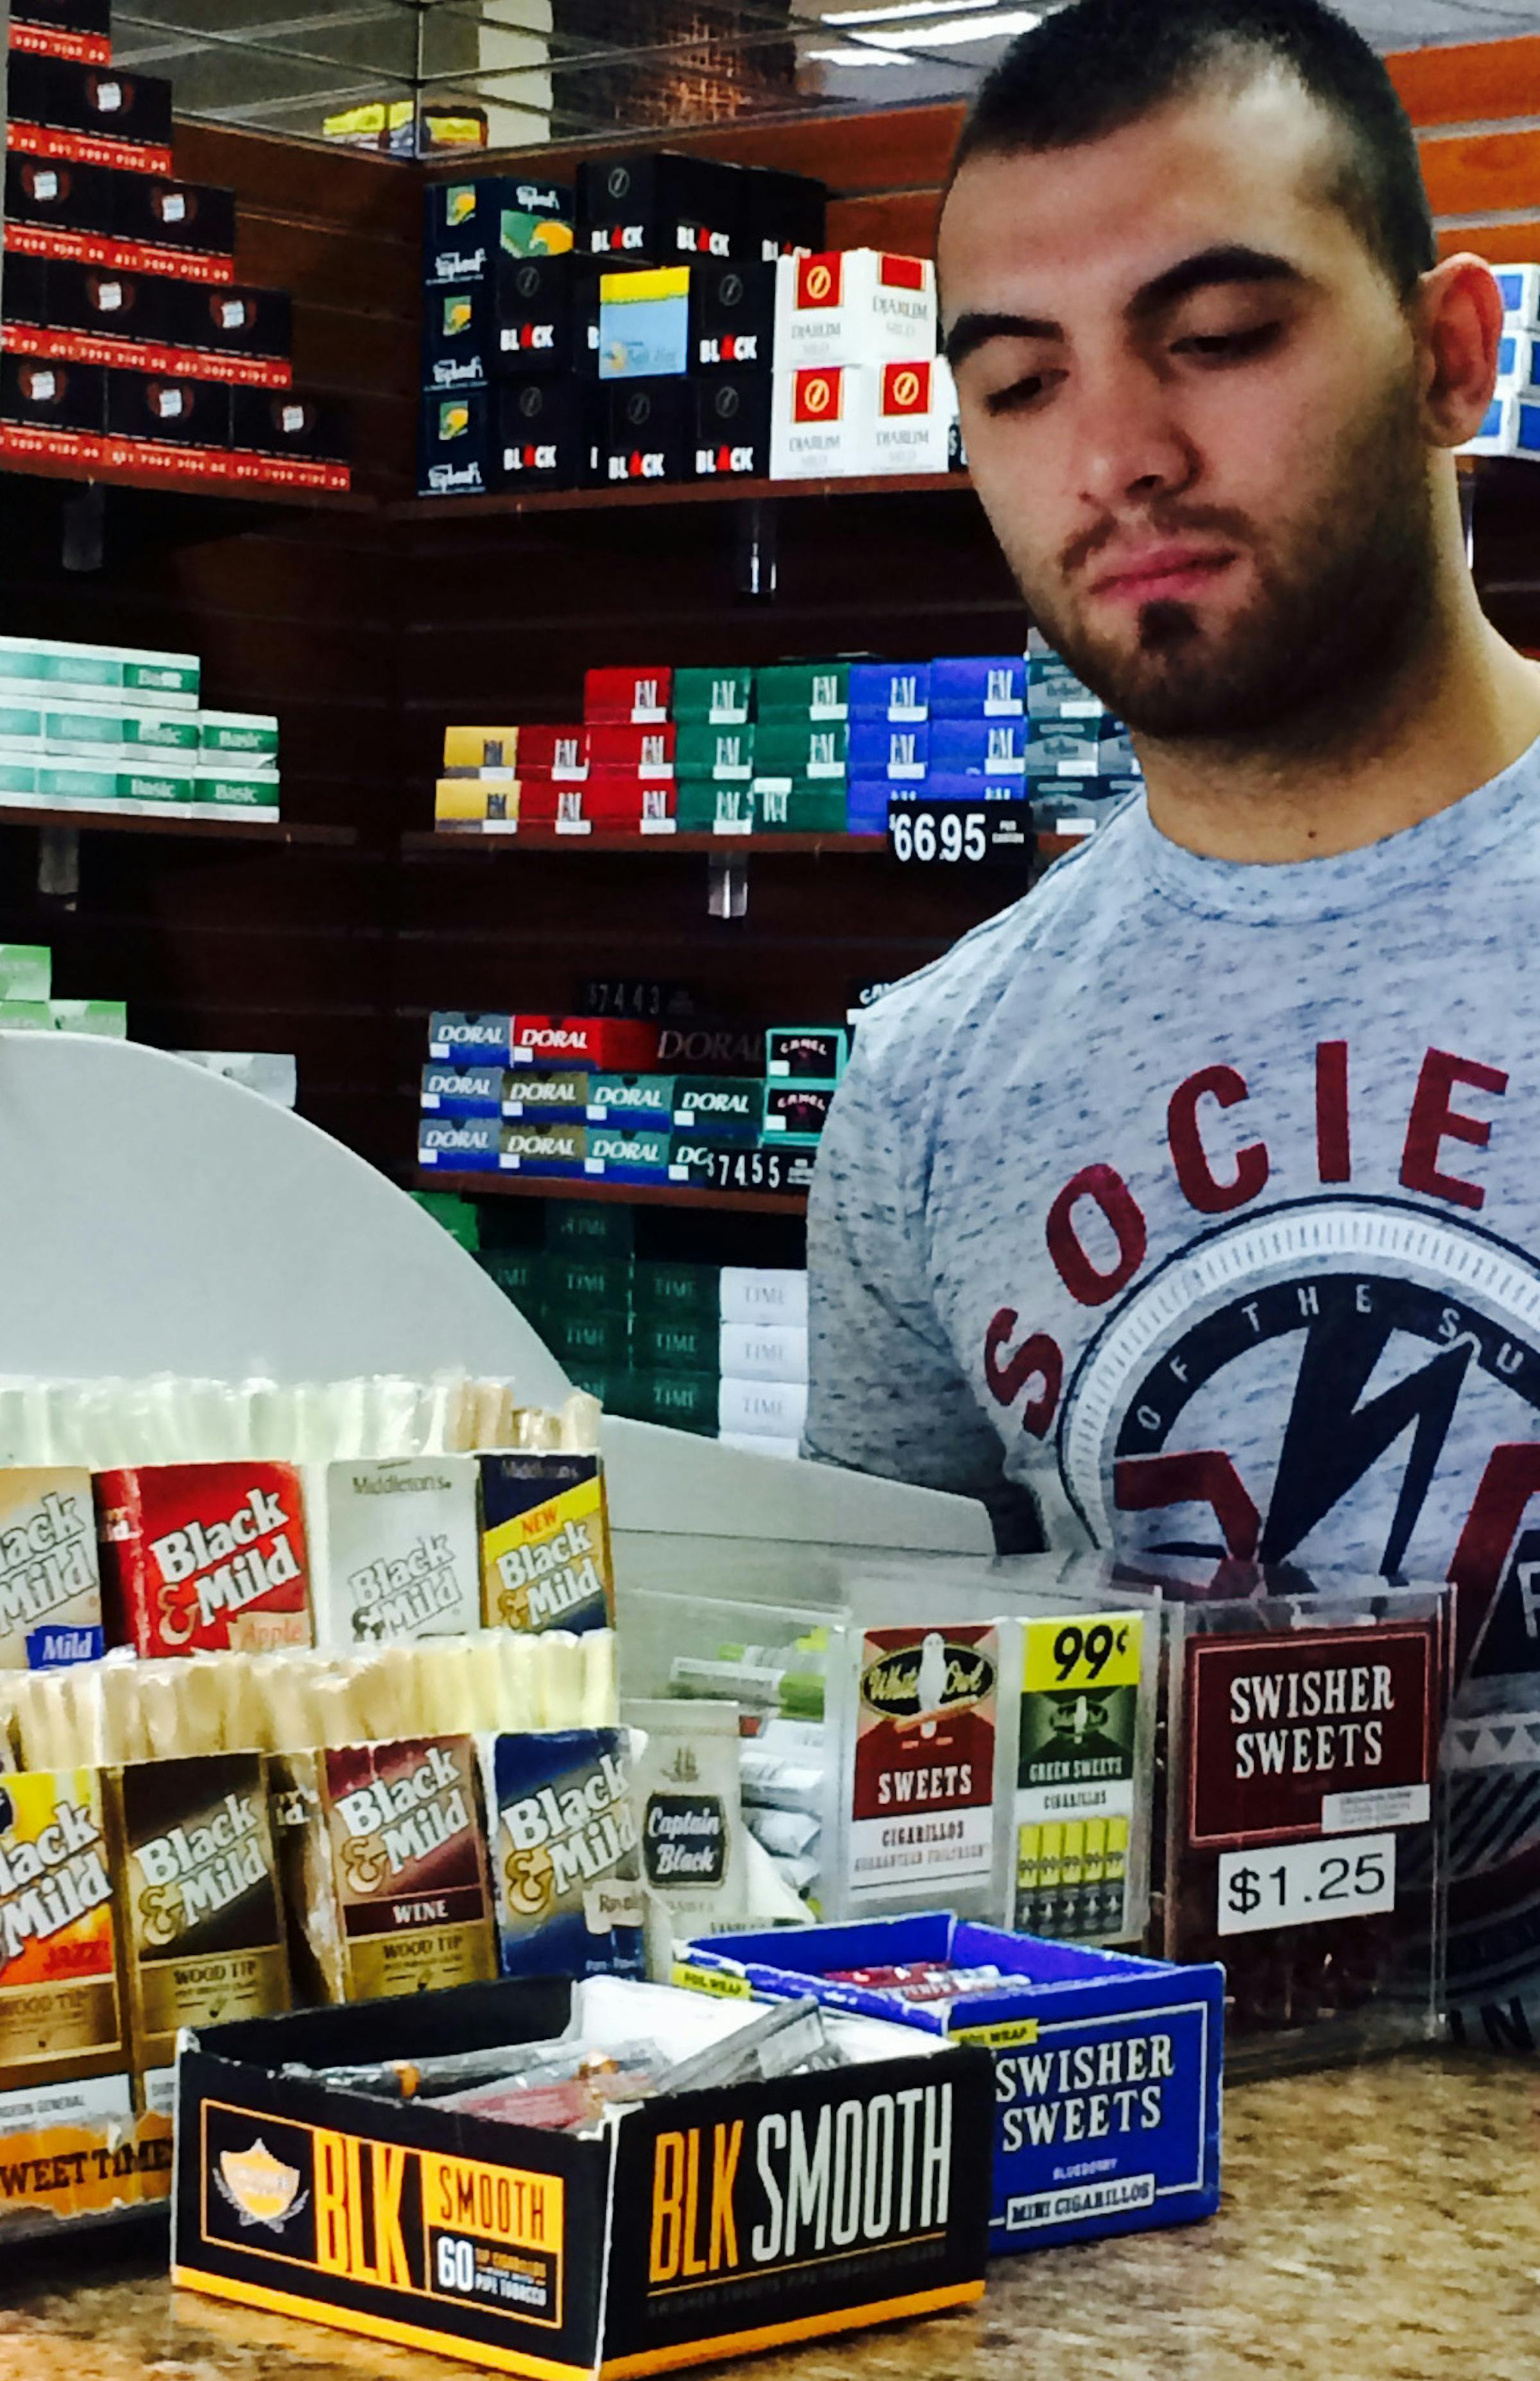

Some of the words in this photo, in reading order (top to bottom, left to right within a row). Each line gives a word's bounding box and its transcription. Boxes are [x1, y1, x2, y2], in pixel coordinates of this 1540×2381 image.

[438, 1025, 504, 1044] DORAL
[521, 1028, 588, 1049] DORAL
[780, 1039, 827, 1055] CAMEL
[428, 1075, 490, 1095] DORAL
[510, 1083, 576, 1101] DORAL
[594, 1086, 663, 1107] DORAL
[681, 1091, 749, 1113] DORAL
[426, 1130, 490, 1148] DORAL
[507, 1135, 575, 1155] DORAL
[592, 1139, 659, 1162] DORAL
[984, 1040, 1509, 1440] SOCIE
[1136, 1356, 1193, 1430] OF
[1242, 1284, 1373, 1332] THE
[149, 1488, 290, 1584] Black
[522, 1505, 559, 1535] NEW
[194, 1533, 301, 1627] Mild
[349, 1534, 456, 1607] Black
[496, 1521, 594, 1590] Black
[379, 1566, 463, 1635] Mild
[526, 1557, 602, 1626] Mild
[42, 1633, 92, 1660] Mild
[1230, 1665, 1394, 1724] SWISHER
[1236, 1721, 1383, 1779] SWEETS
[335, 1746, 461, 1838] Black
[501, 1754, 630, 1850] Black
[878, 1764, 972, 1805] SWEETS
[133, 1793, 257, 1886] Black
[381, 1789, 470, 1877] Mild
[548, 1804, 639, 1895] Mild
[648, 1806, 720, 1839] Captain
[882, 1820, 964, 1847] CIGARILLOS
[179, 1837, 268, 1927] Mild
[656, 1843, 715, 1875] Black
[1228, 1852, 1385, 1914] $1.25
[2, 1850, 114, 1958] Mild
[393, 1899, 449, 1924] WINE
[174, 1965, 225, 1986] WOOD
[384, 1940, 432, 1958] WOOD
[996, 2034, 1176, 2103] SWISHER
[1003, 2086, 1161, 2152] SWEETS
[315, 2130, 412, 2289] BLK
[439, 2164, 545, 2241] SMOOTH
[649, 2119, 744, 2283] BLK
[751, 2083, 952, 2262] SMOOTH
[1012, 2201, 1050, 2223] MINI
[1056, 2182, 1151, 2215] CIGARILLOS
[438, 2236, 474, 2292] 60
